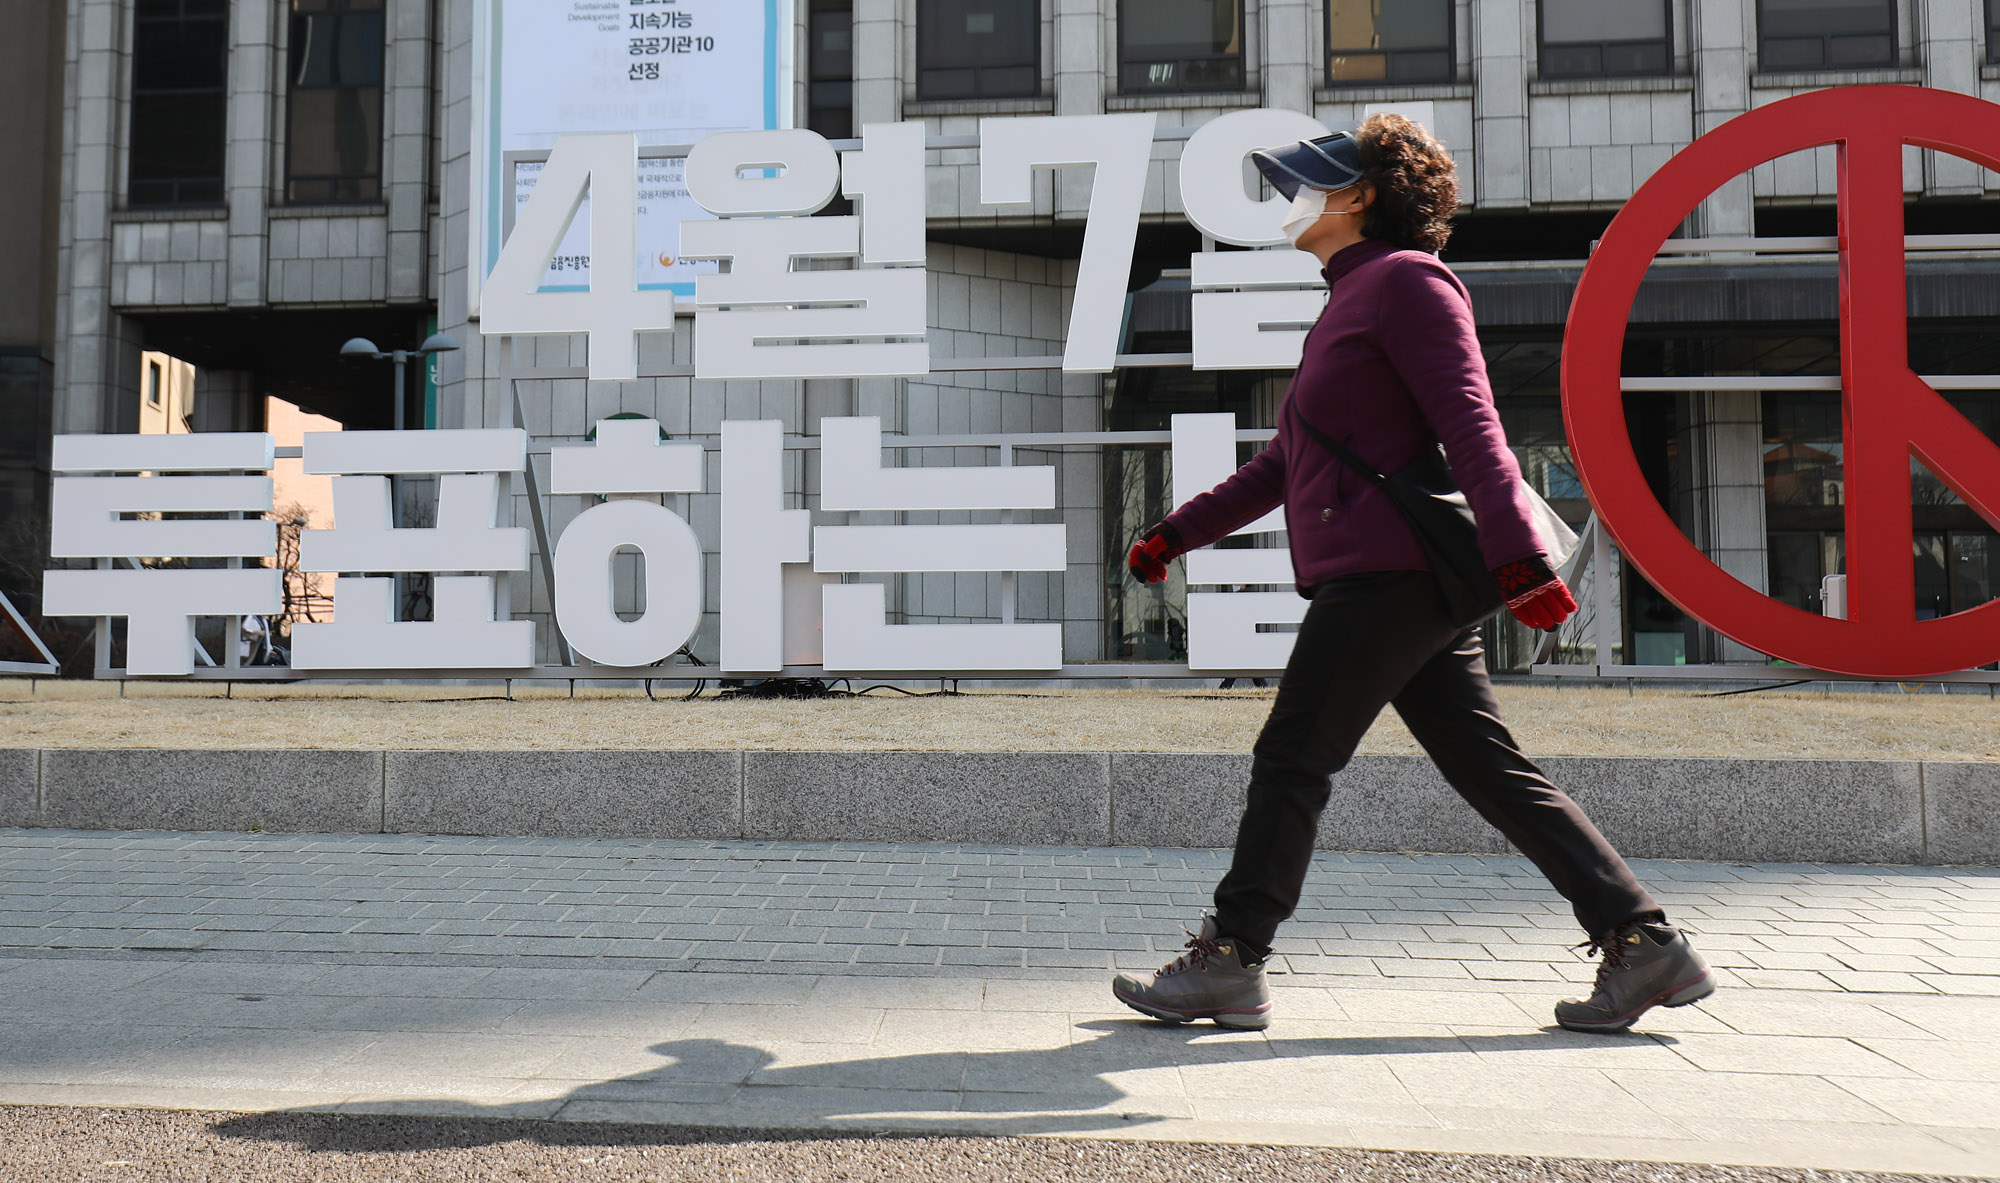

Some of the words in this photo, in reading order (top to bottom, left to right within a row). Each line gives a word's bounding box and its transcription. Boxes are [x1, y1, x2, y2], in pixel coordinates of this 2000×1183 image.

[568, 13, 620, 22] Development
[629, 11, 693, 30] 지속가능
[598, 24, 620, 32] Goals
[628, 36, 693, 56] 공공기관
[695, 36, 715, 52] 10
[628, 62, 660, 81] 선정
[638, 189, 676, 199] 금융지원에
[480, 121, 929, 381] 4월
[43, 416, 1067, 676] 투표하는
